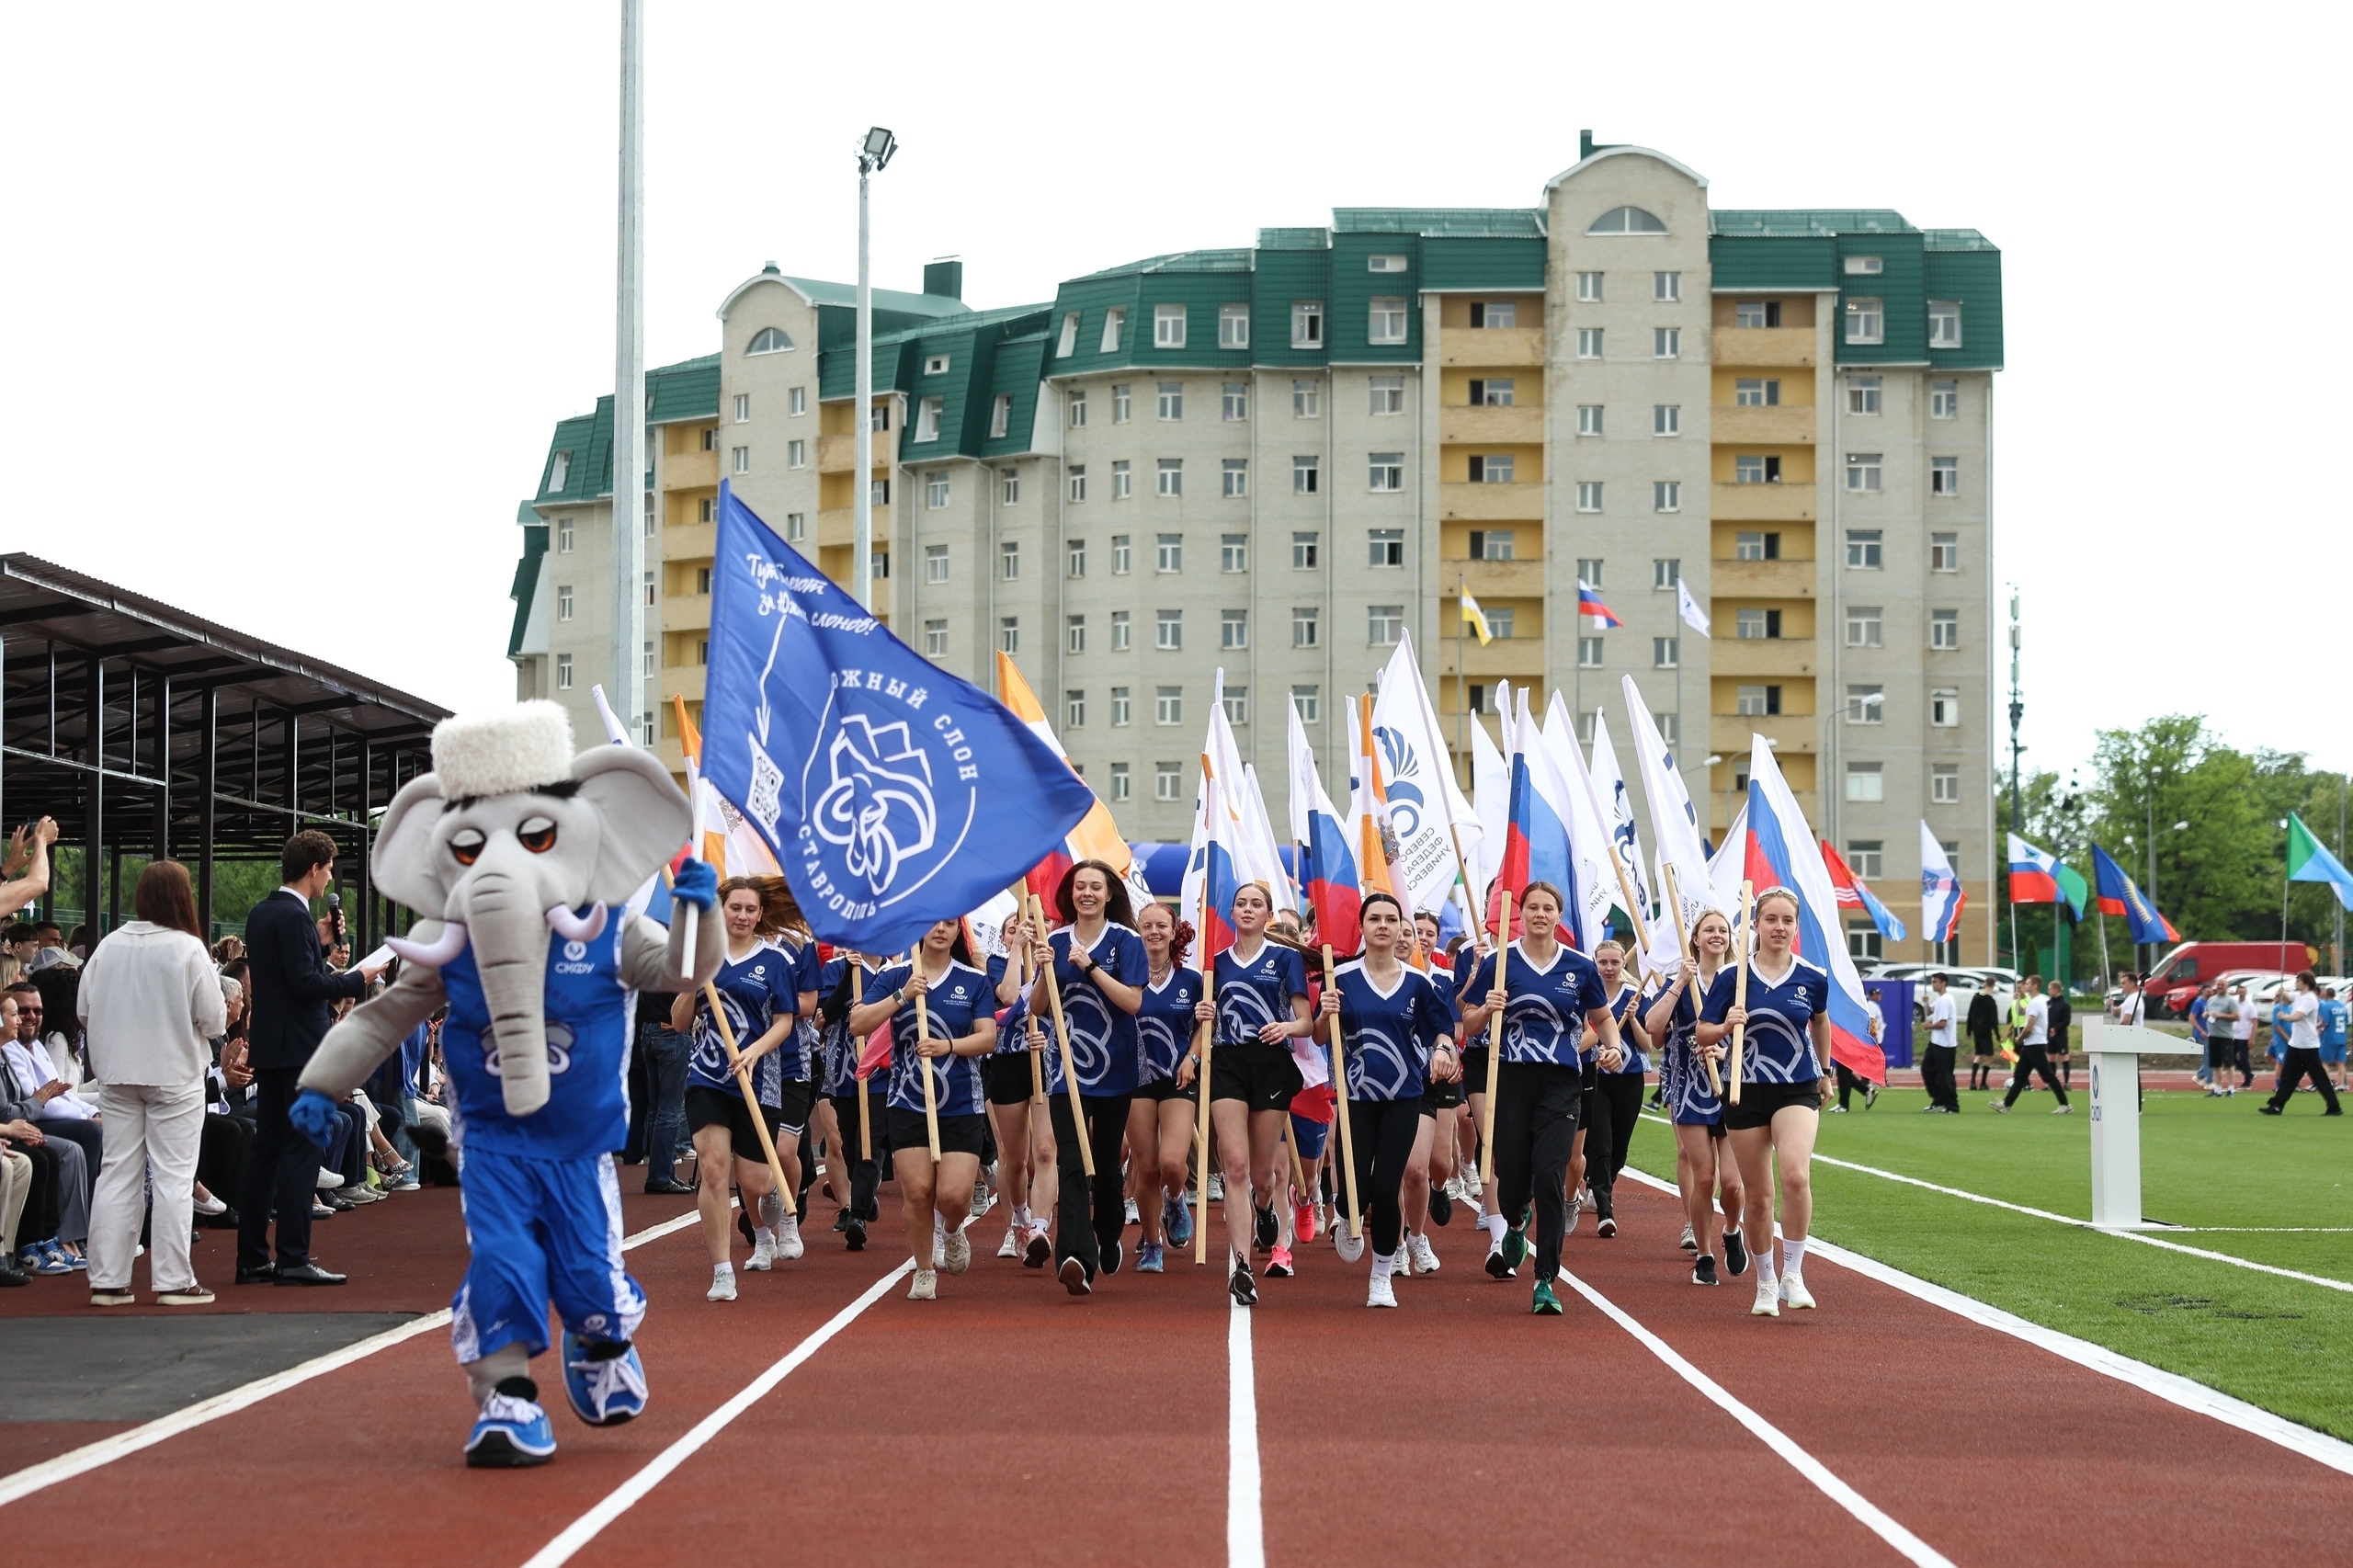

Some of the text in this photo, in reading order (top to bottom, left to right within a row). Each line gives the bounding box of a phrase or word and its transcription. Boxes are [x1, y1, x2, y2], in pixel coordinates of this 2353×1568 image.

[811, 611, 880, 636] слонов!
[934, 713, 979, 781] СЛОН
[554, 961, 596, 974] СКФУ
[2335, 1017, 2346, 1033] 5
